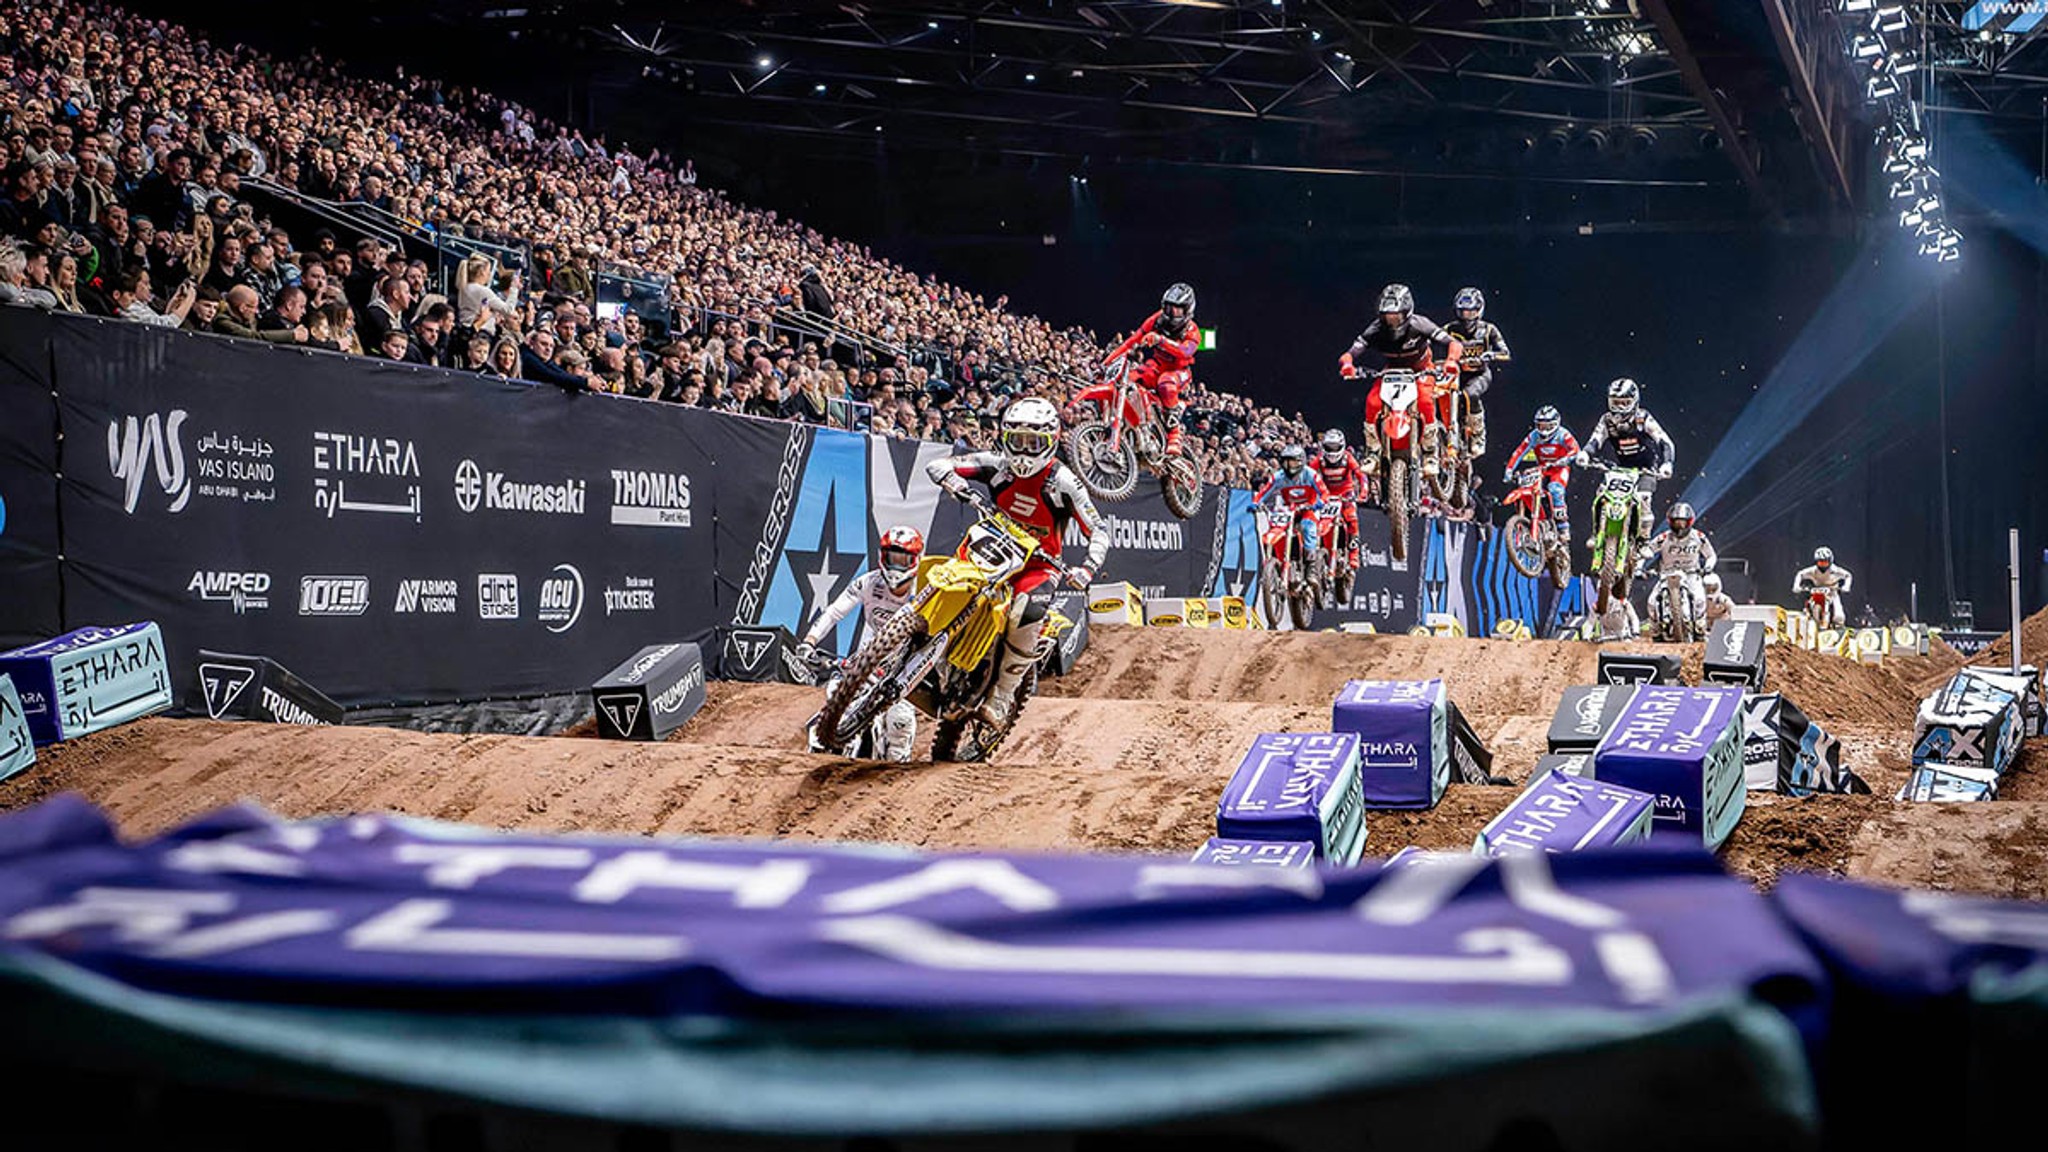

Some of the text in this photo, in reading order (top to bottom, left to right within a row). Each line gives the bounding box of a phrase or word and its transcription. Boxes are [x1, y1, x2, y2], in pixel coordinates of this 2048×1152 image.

[314, 431, 420, 478] ETHARA
[198, 458, 275, 483] YAS ISLAND
[486, 472, 586, 514] Kawasaki
[611, 469, 690, 509] THOMAS
[188, 571, 271, 592] AMPED
[421, 580, 458, 596] ARMOR
[540, 580, 574, 608] ACU
[421, 597, 456, 612] VISION
[482, 604, 517, 616] STORE
[61, 637, 161, 695] ETHARA
